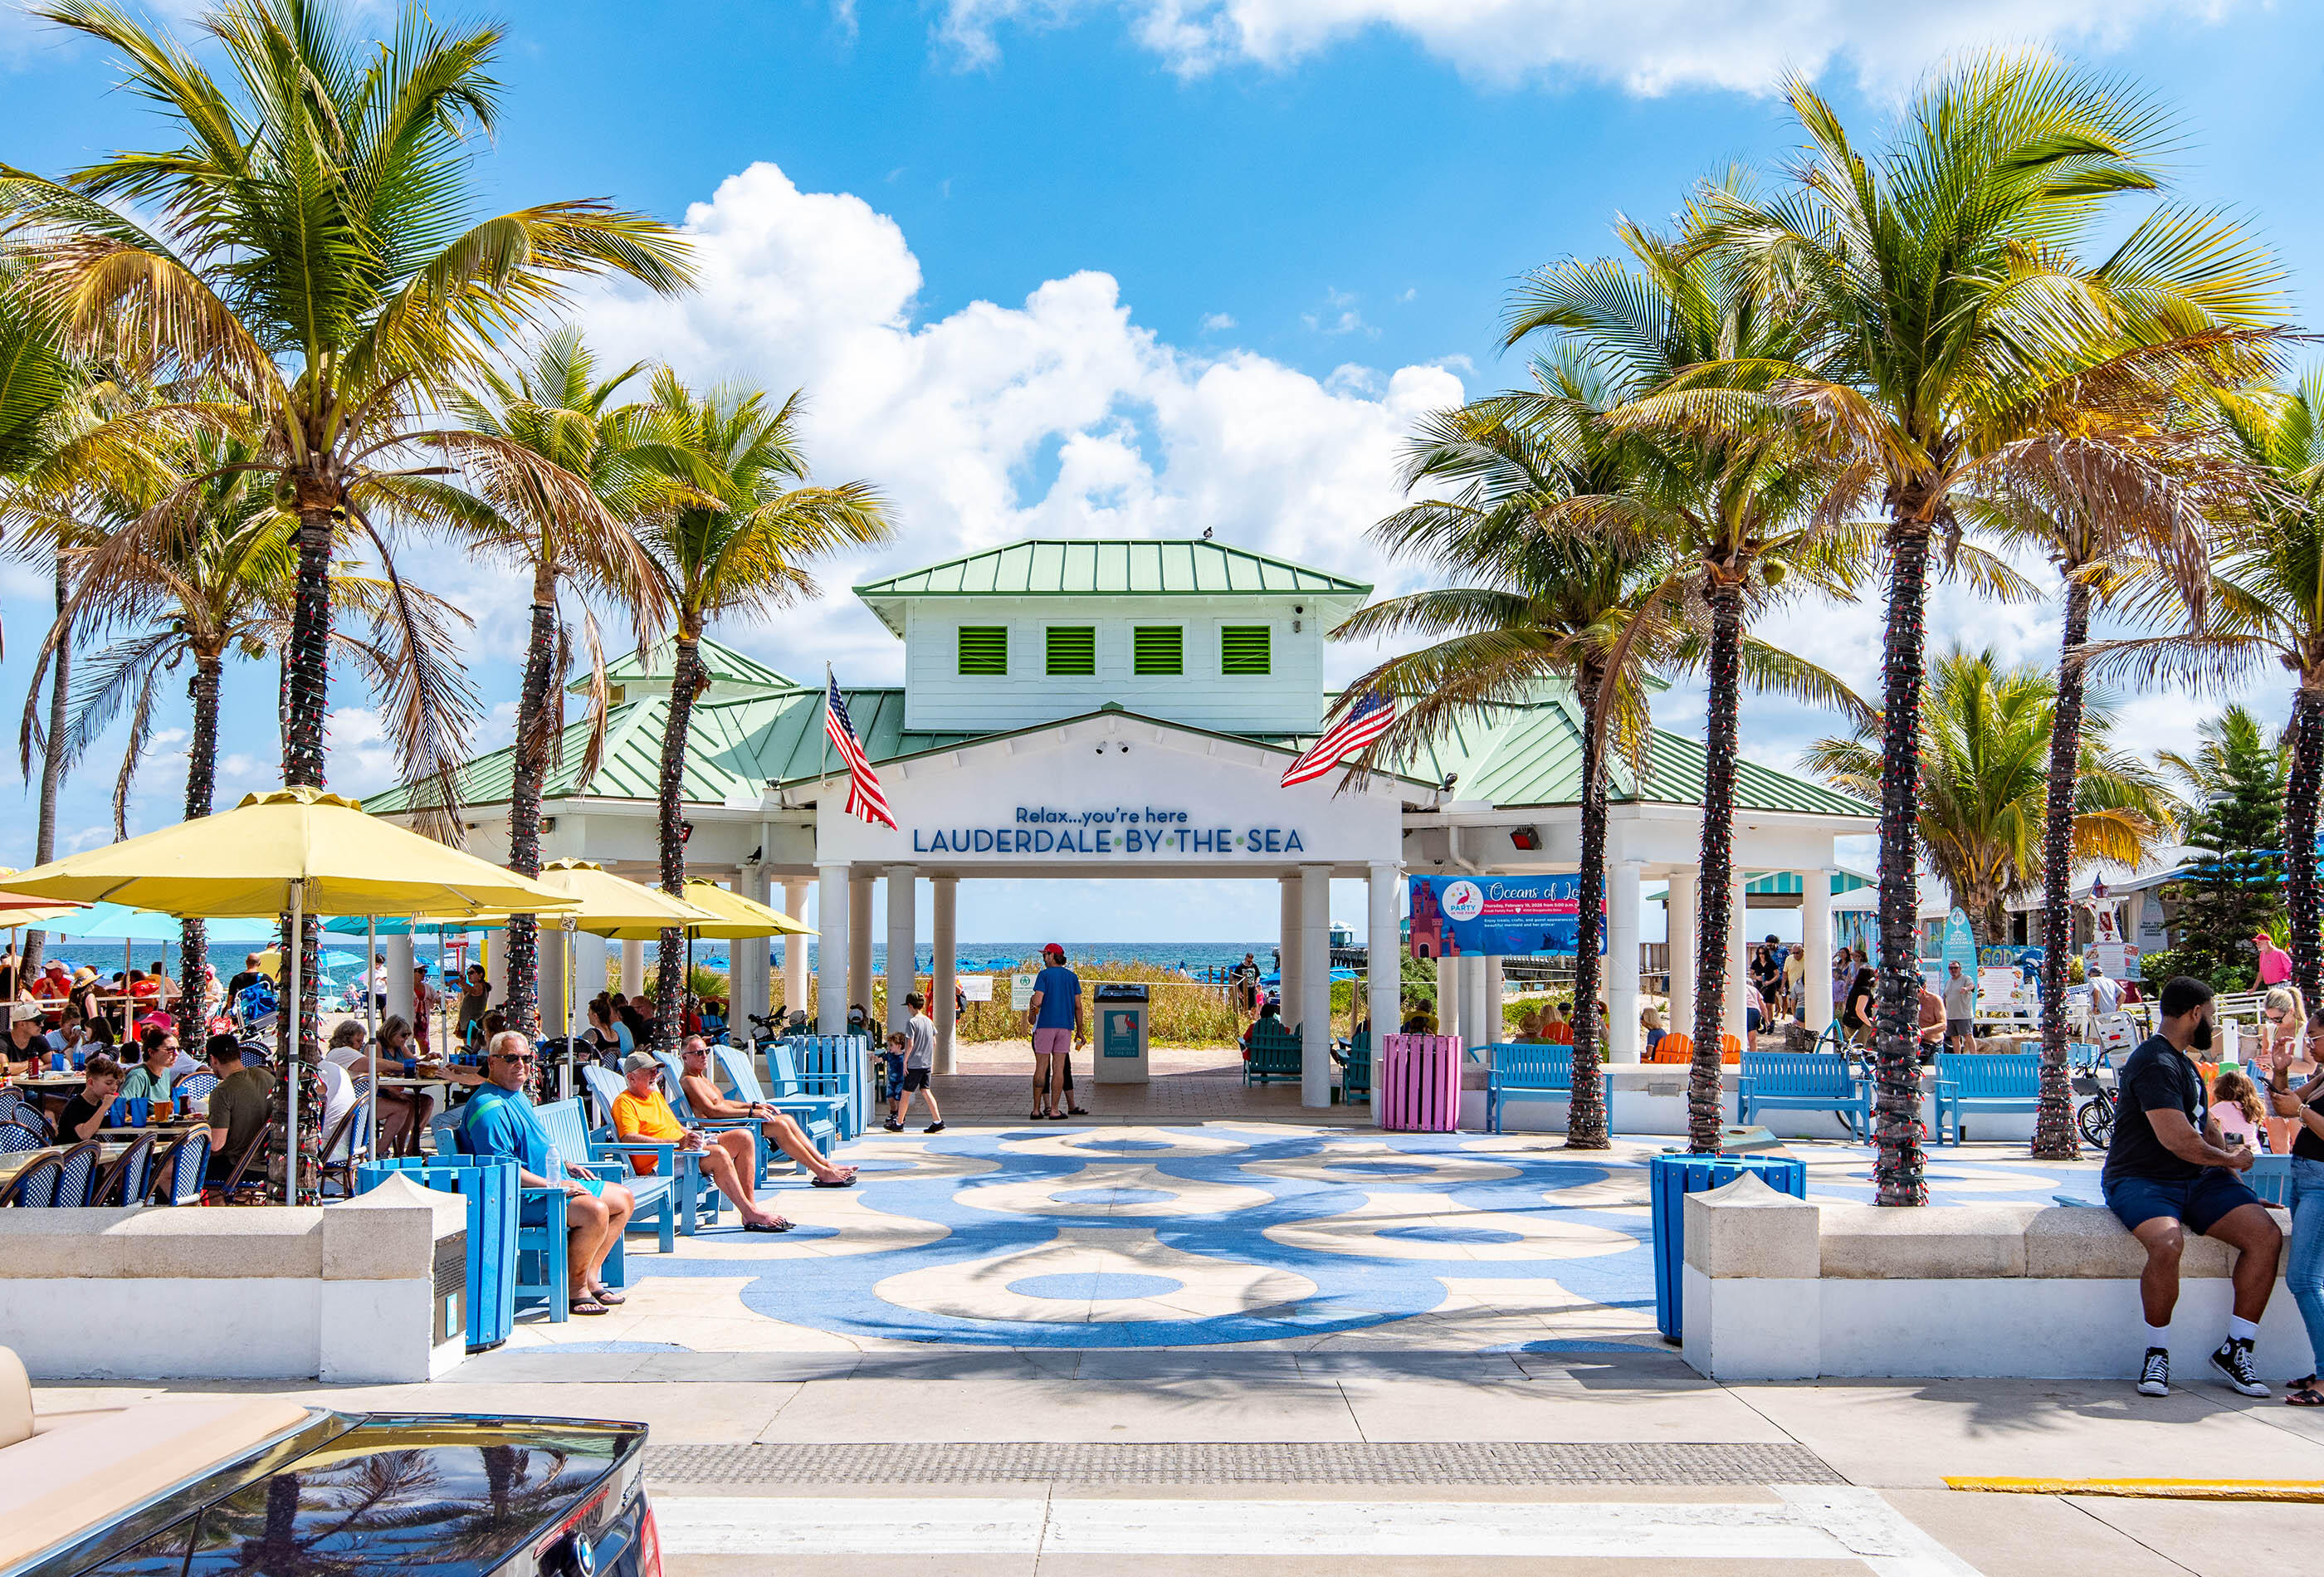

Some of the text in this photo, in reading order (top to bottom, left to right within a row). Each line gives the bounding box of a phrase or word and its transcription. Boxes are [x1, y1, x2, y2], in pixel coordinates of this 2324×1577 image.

[1145, 806, 1188, 823] here
[913, 829, 1305, 852] LAUDERDALE BY THE SEA
[1487, 881, 1580, 901] Oceans of Lo
[2104, 932, 2112, 941] 2
